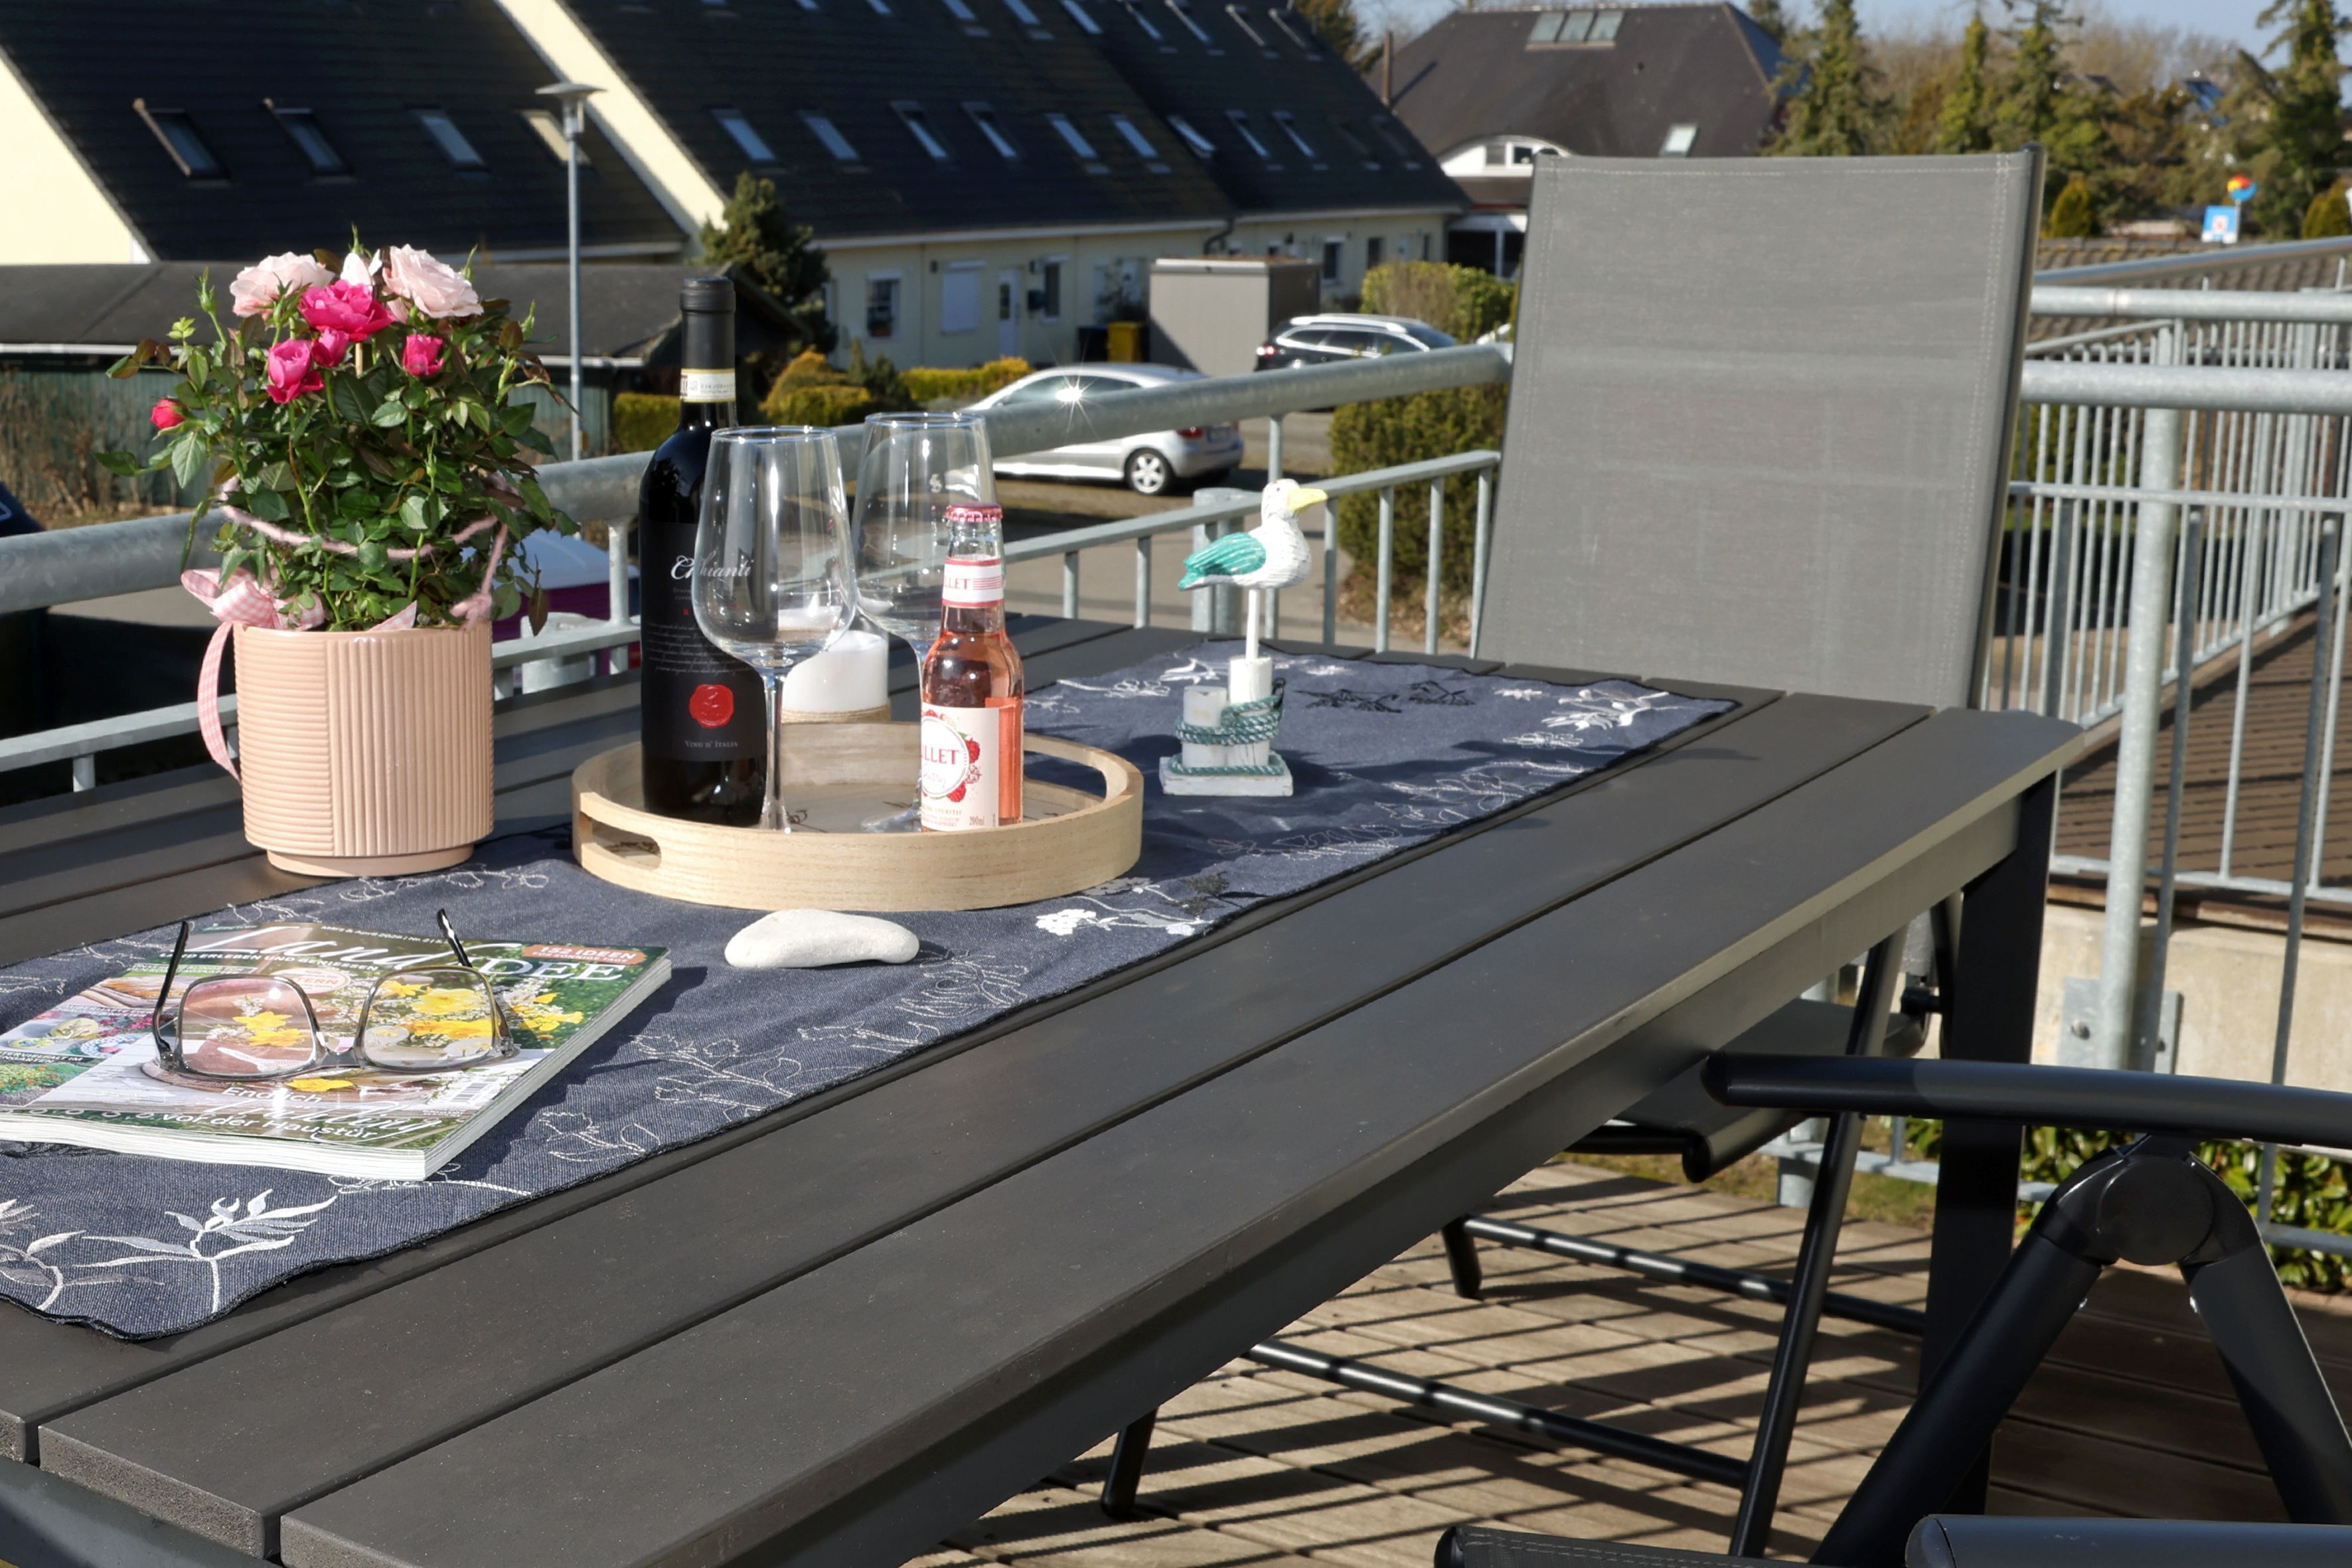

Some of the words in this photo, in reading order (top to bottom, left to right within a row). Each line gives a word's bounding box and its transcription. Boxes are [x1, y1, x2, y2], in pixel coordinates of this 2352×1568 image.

[540, 946, 573, 955] 152
[575, 948, 637, 960] IDEEN
[297, 959, 379, 971] GENIESSEN
[297, 977, 339, 985] TERN
[220, 1087, 323, 1103] Endich
[163, 1113, 207, 1123] vor
[210, 1113, 259, 1127] der
[262, 1119, 378, 1138] Haustür
